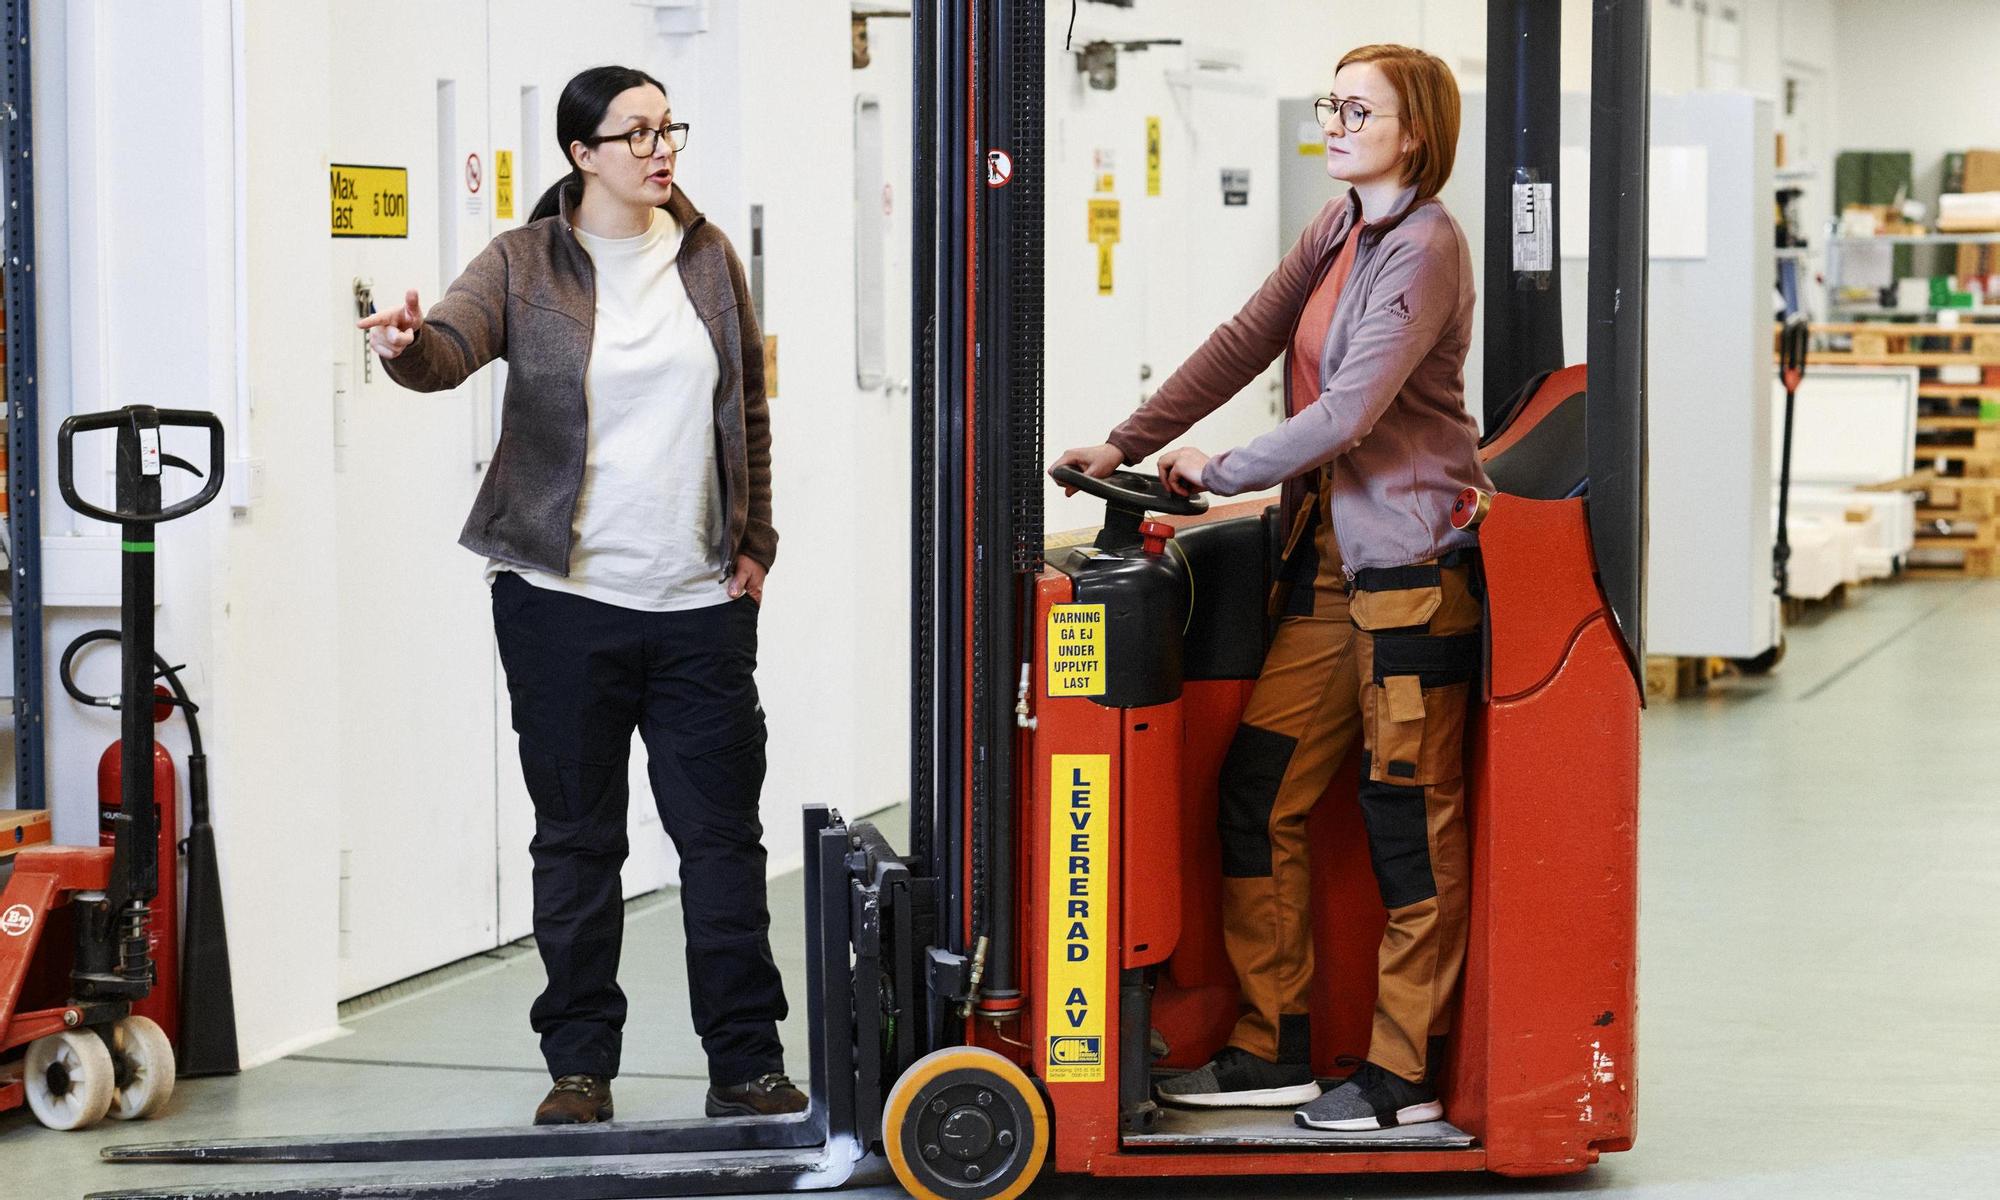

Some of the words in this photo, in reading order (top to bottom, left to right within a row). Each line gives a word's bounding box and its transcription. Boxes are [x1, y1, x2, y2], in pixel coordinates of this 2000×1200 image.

[330, 171, 358, 200] Max.
[373, 192, 380, 217] 5
[383, 189, 405, 217] ton
[331, 200, 354, 229] last
[1053, 612, 1101, 624] VARNING
[1061, 625, 1075, 640] GÅ
[1080, 628, 1093, 640] EJ
[1058, 645, 1095, 656] UNDER
[1054, 661, 1098, 672] UPPLYFT
[1063, 677, 1090, 689] LAST
[1066, 768, 1092, 962] LEVERERAD
[7, 910, 31, 928] BT
[1065, 987, 1089, 1028] AV
